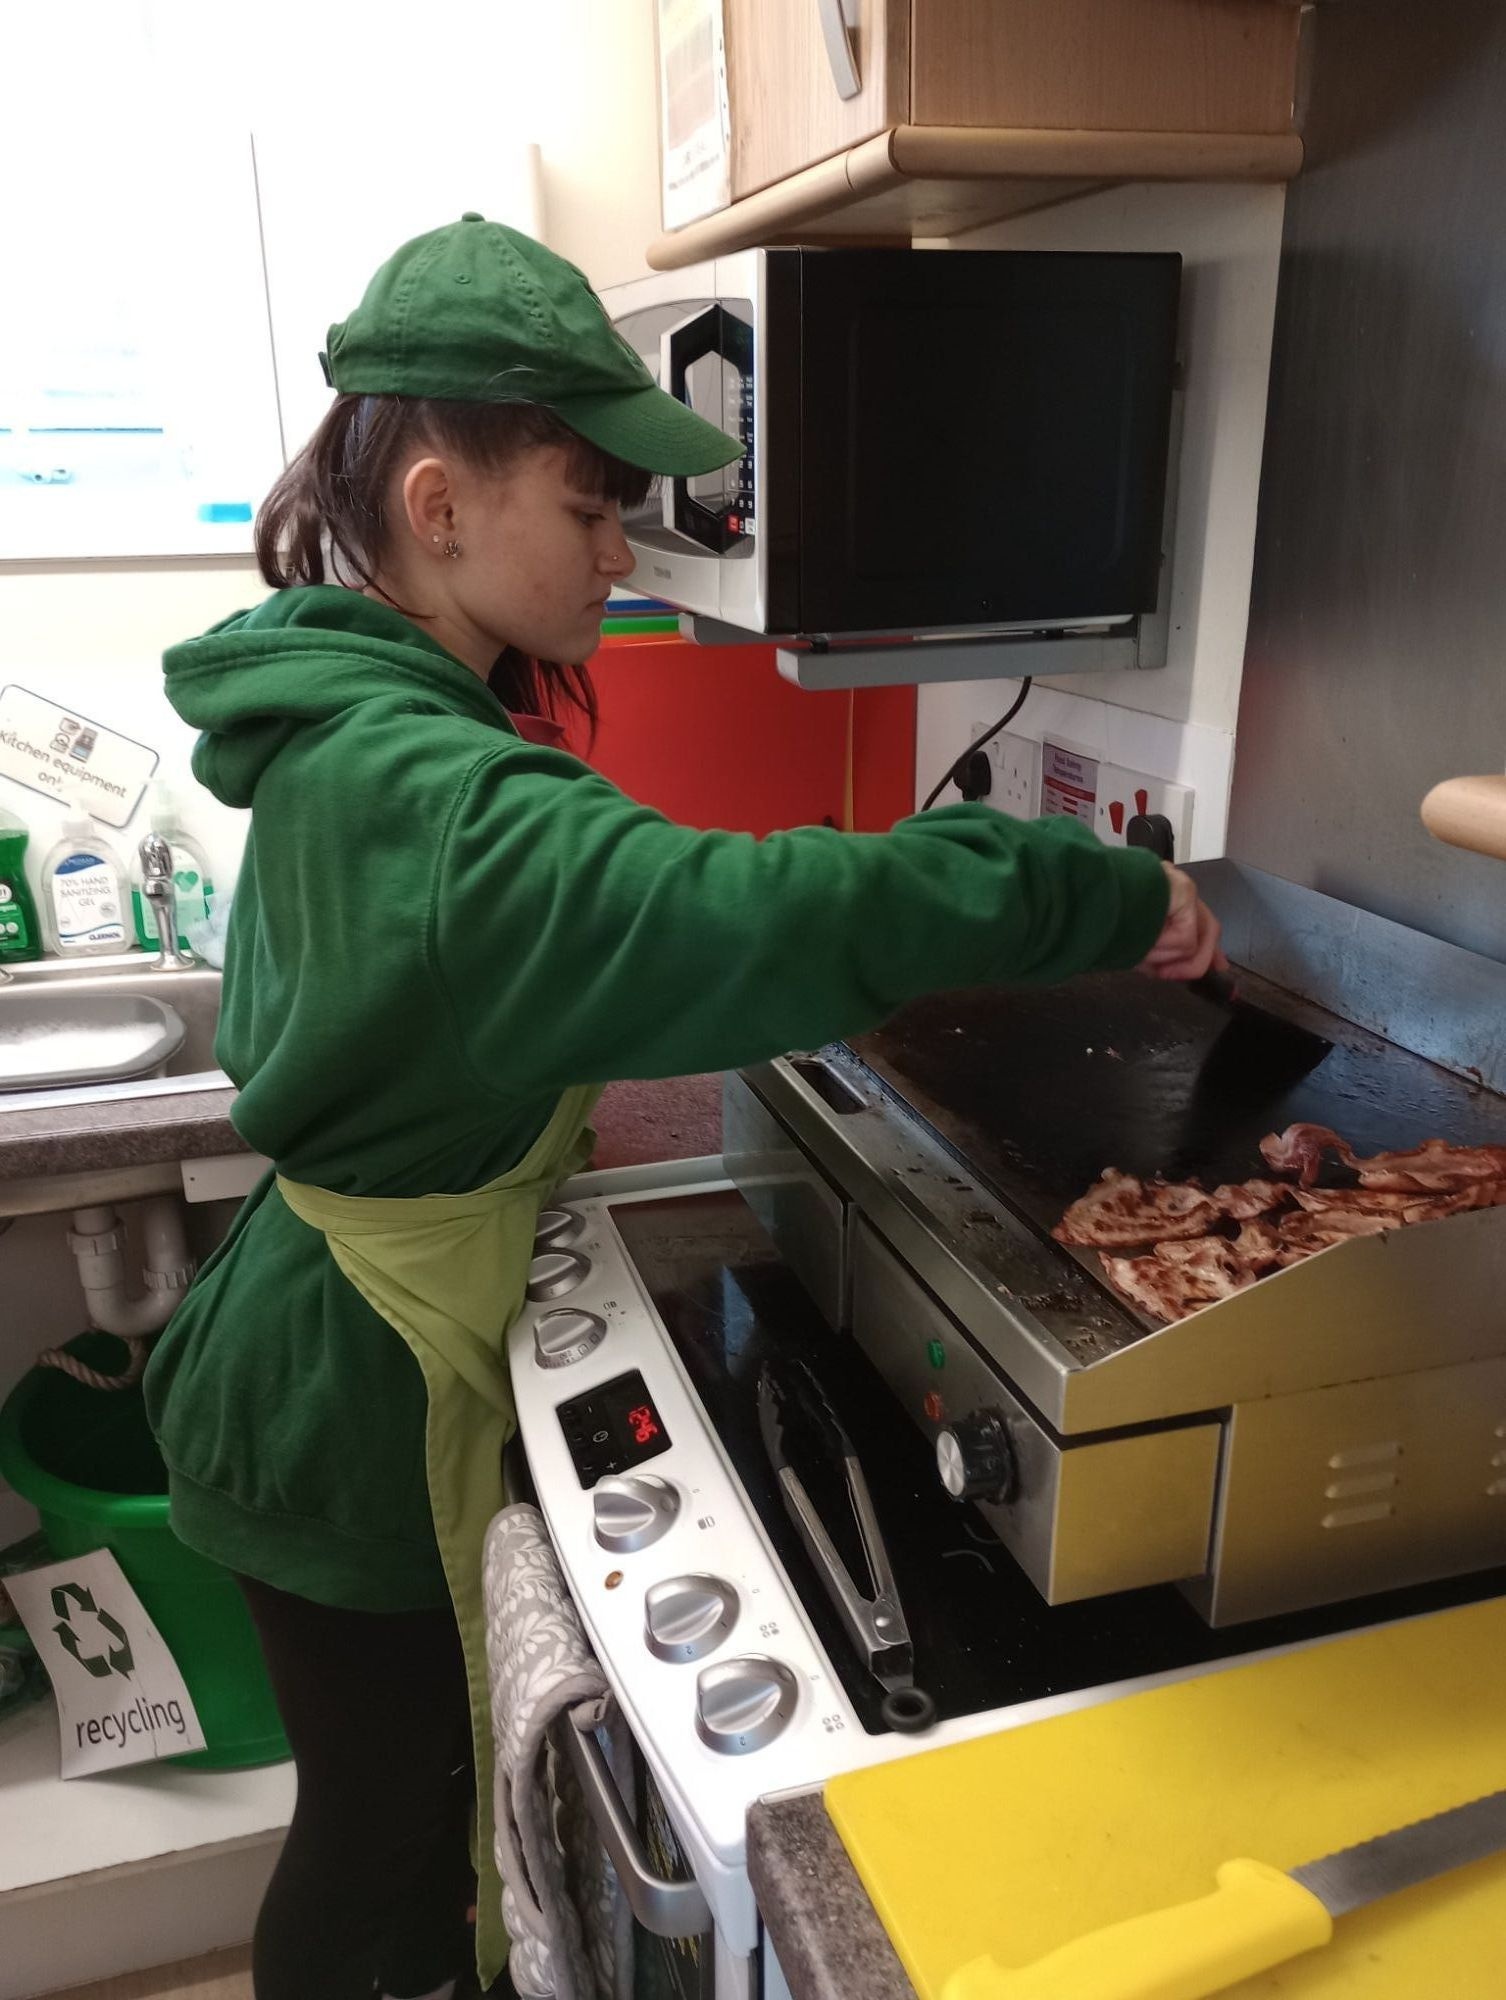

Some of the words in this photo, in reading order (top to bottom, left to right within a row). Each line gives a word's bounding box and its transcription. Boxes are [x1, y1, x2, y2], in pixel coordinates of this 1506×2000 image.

[53, 758, 127, 798] equipment
[81, 875, 109, 885] HAND
[76, 1696, 187, 1748] recycling
